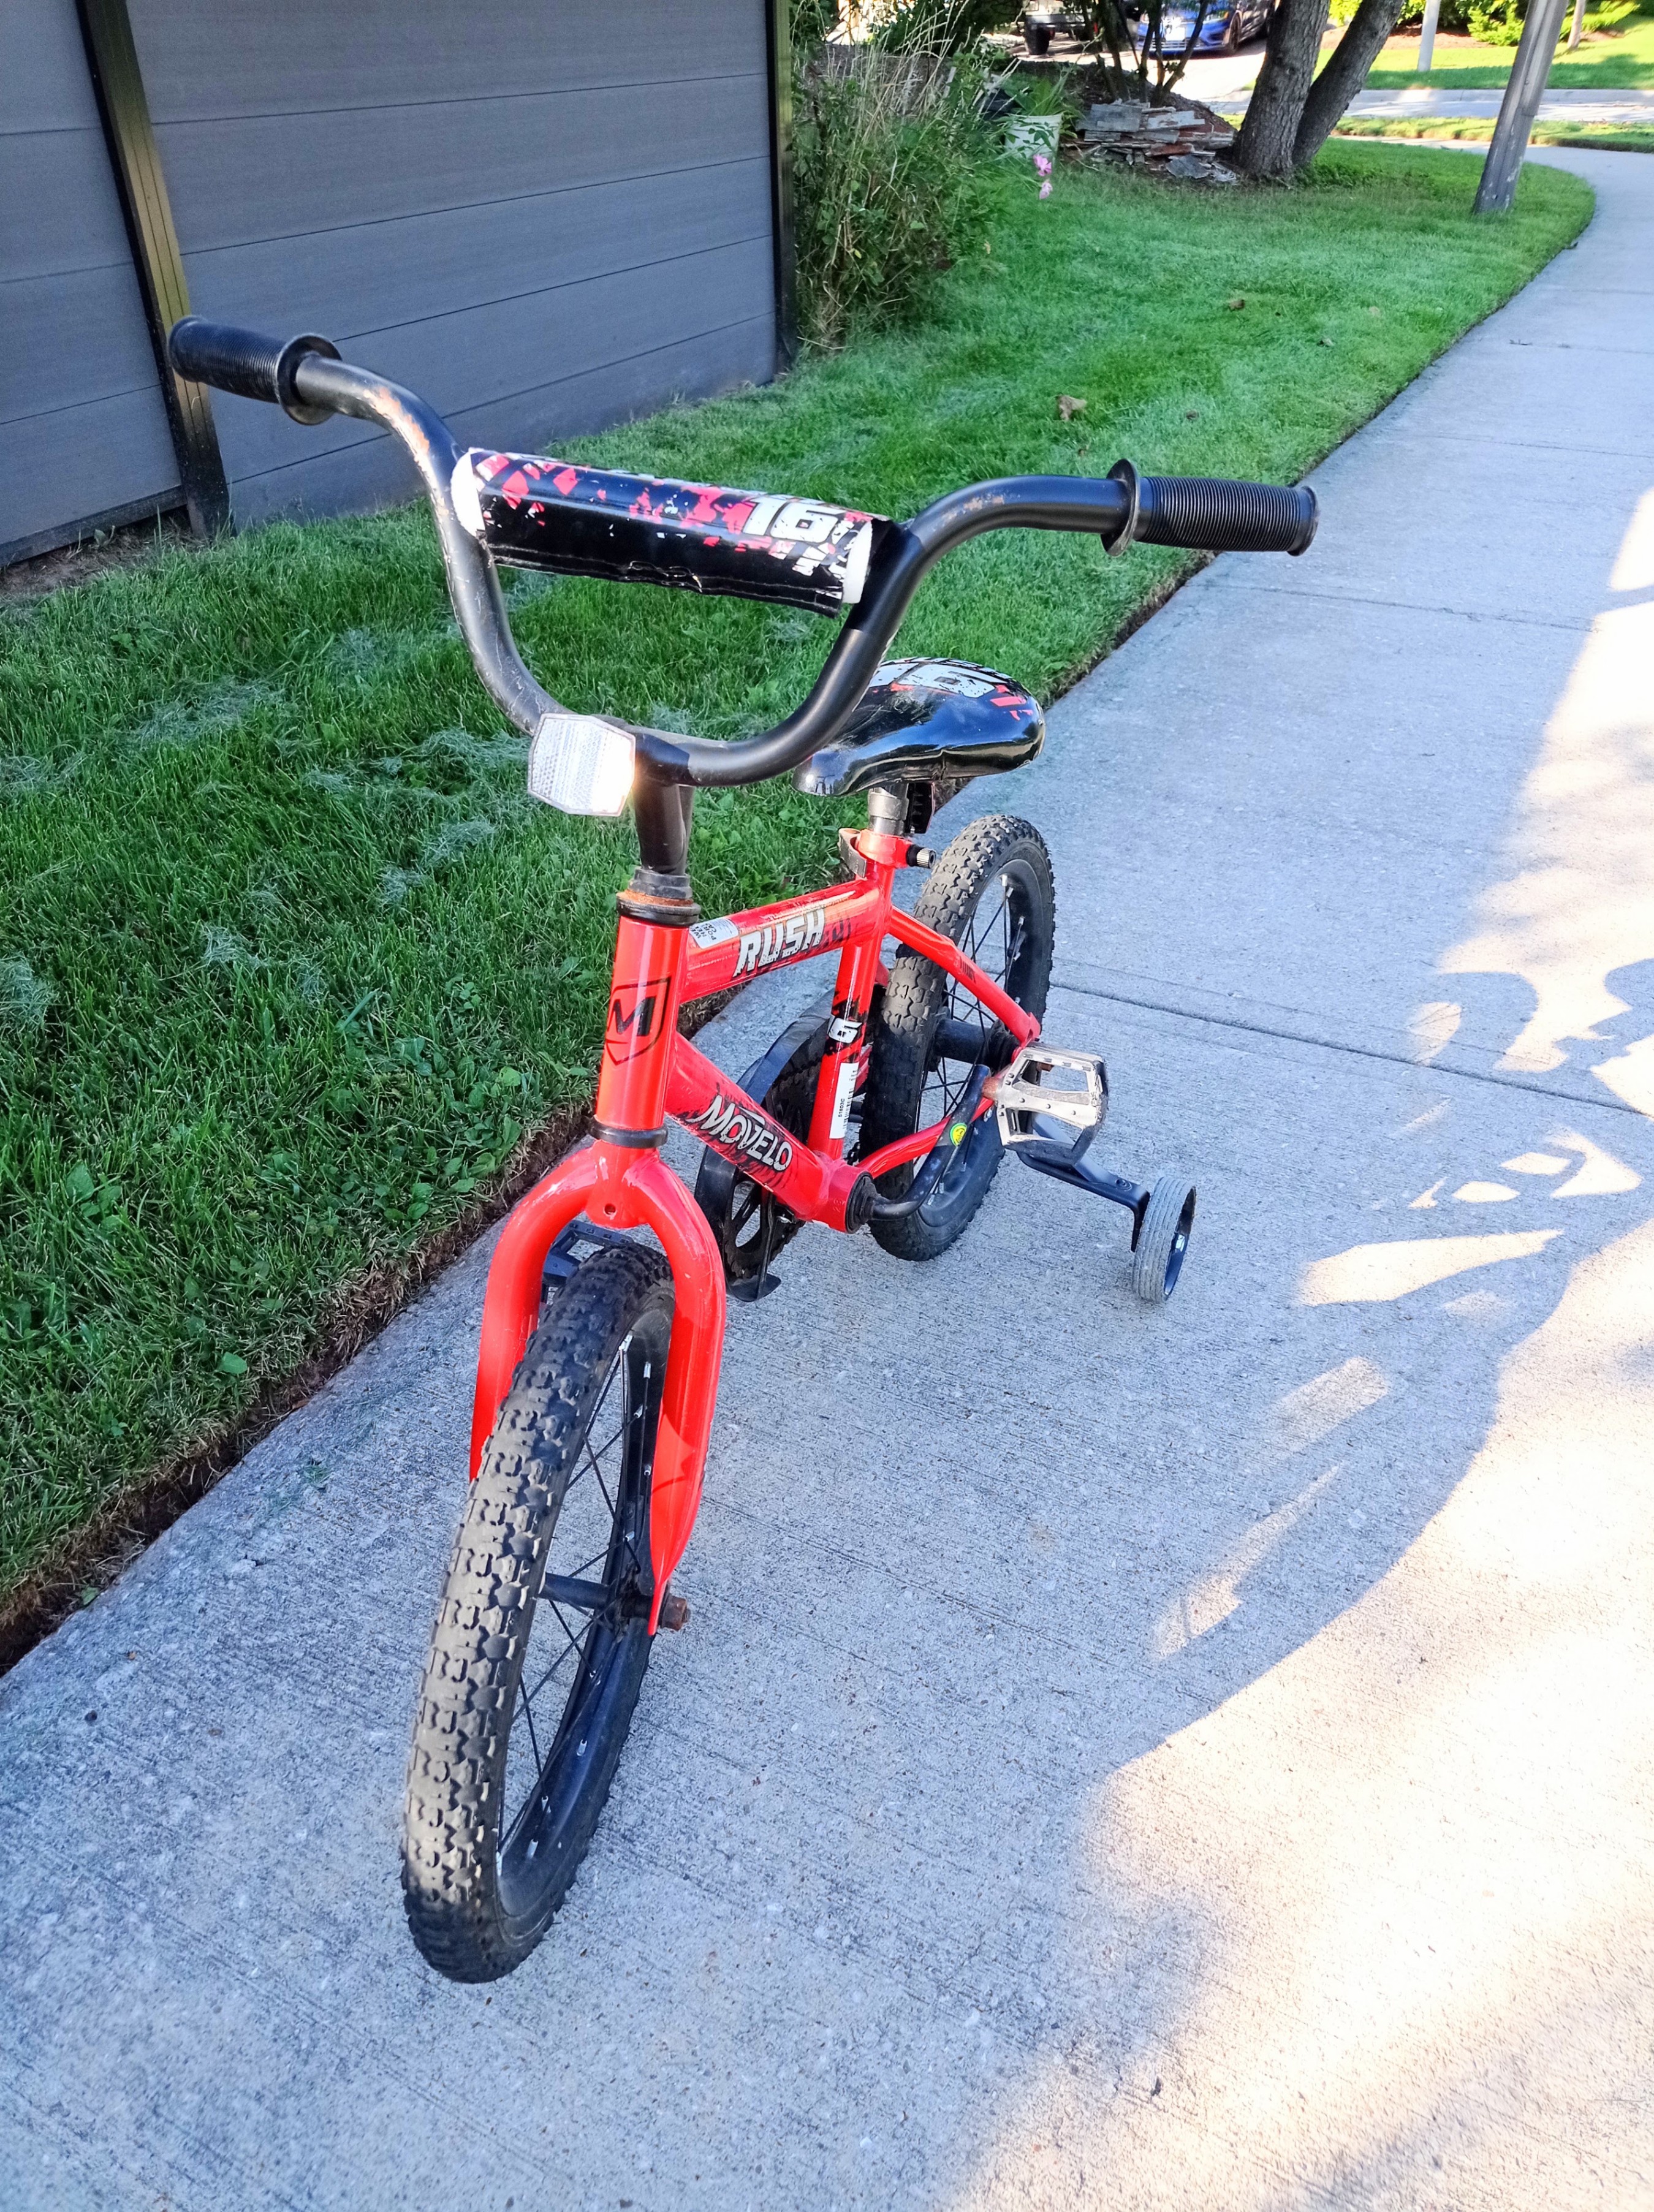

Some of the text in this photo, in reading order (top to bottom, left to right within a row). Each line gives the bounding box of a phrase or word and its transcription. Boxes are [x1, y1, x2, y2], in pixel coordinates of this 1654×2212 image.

[742, 496, 848, 544] 16
[732, 908, 825, 977] RUSH
[685, 1094, 793, 1172] MOVELO
